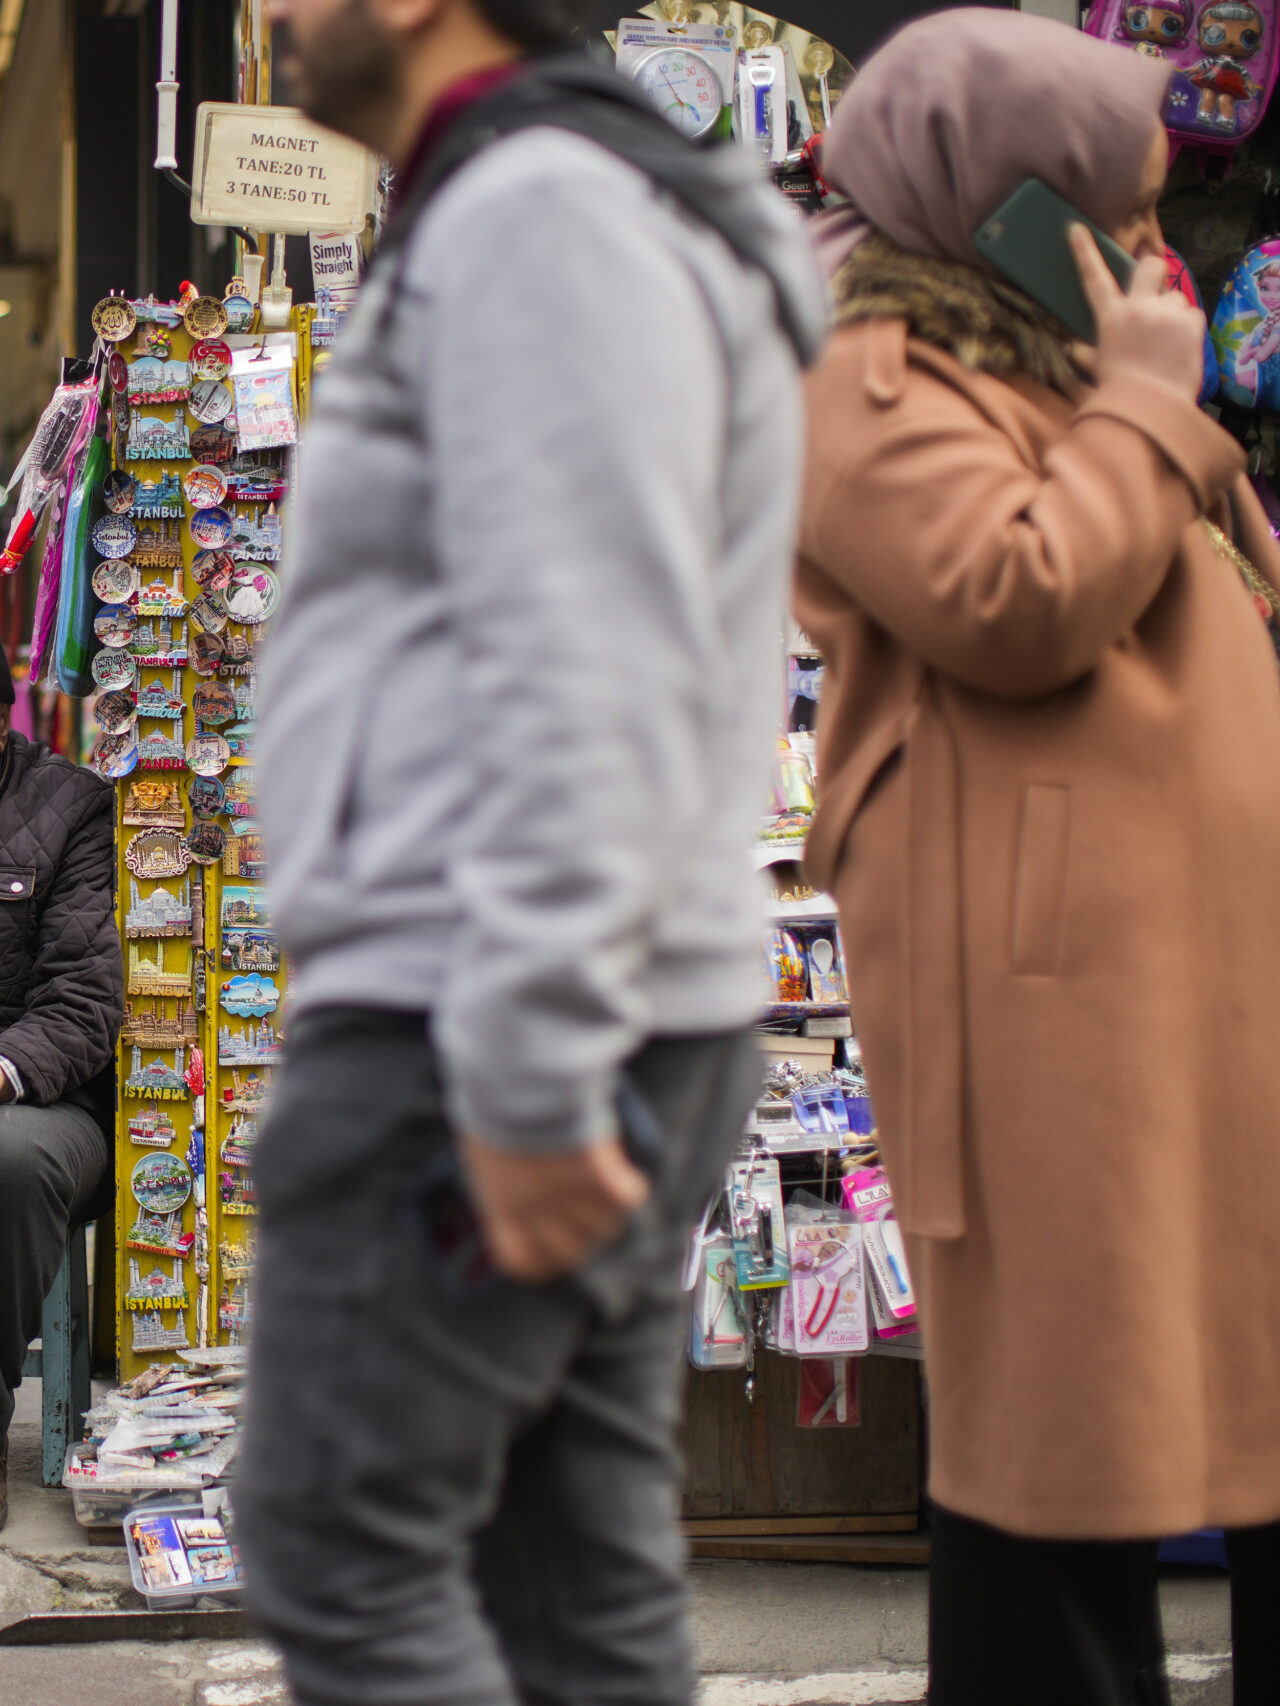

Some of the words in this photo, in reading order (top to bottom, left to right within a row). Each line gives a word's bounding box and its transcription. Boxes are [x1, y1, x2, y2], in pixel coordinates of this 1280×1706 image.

[685, 65, 697, 77] 30
[696, 78, 707, 88] 40
[698, 92, 709, 102] 50
[250, 133, 319, 153] MAGNET
[236, 156, 303, 177] TANE:20
[307, 165, 327, 180] TL
[226, 181, 236, 194] 3
[240, 182, 307, 203] TANE:50
[311, 192, 331, 206] TL
[312, 242, 353, 260] Simply
[314, 259, 354, 275] Straight
[127, 506, 185, 519] STANBUL
[138, 758, 188, 771] TANBUL
